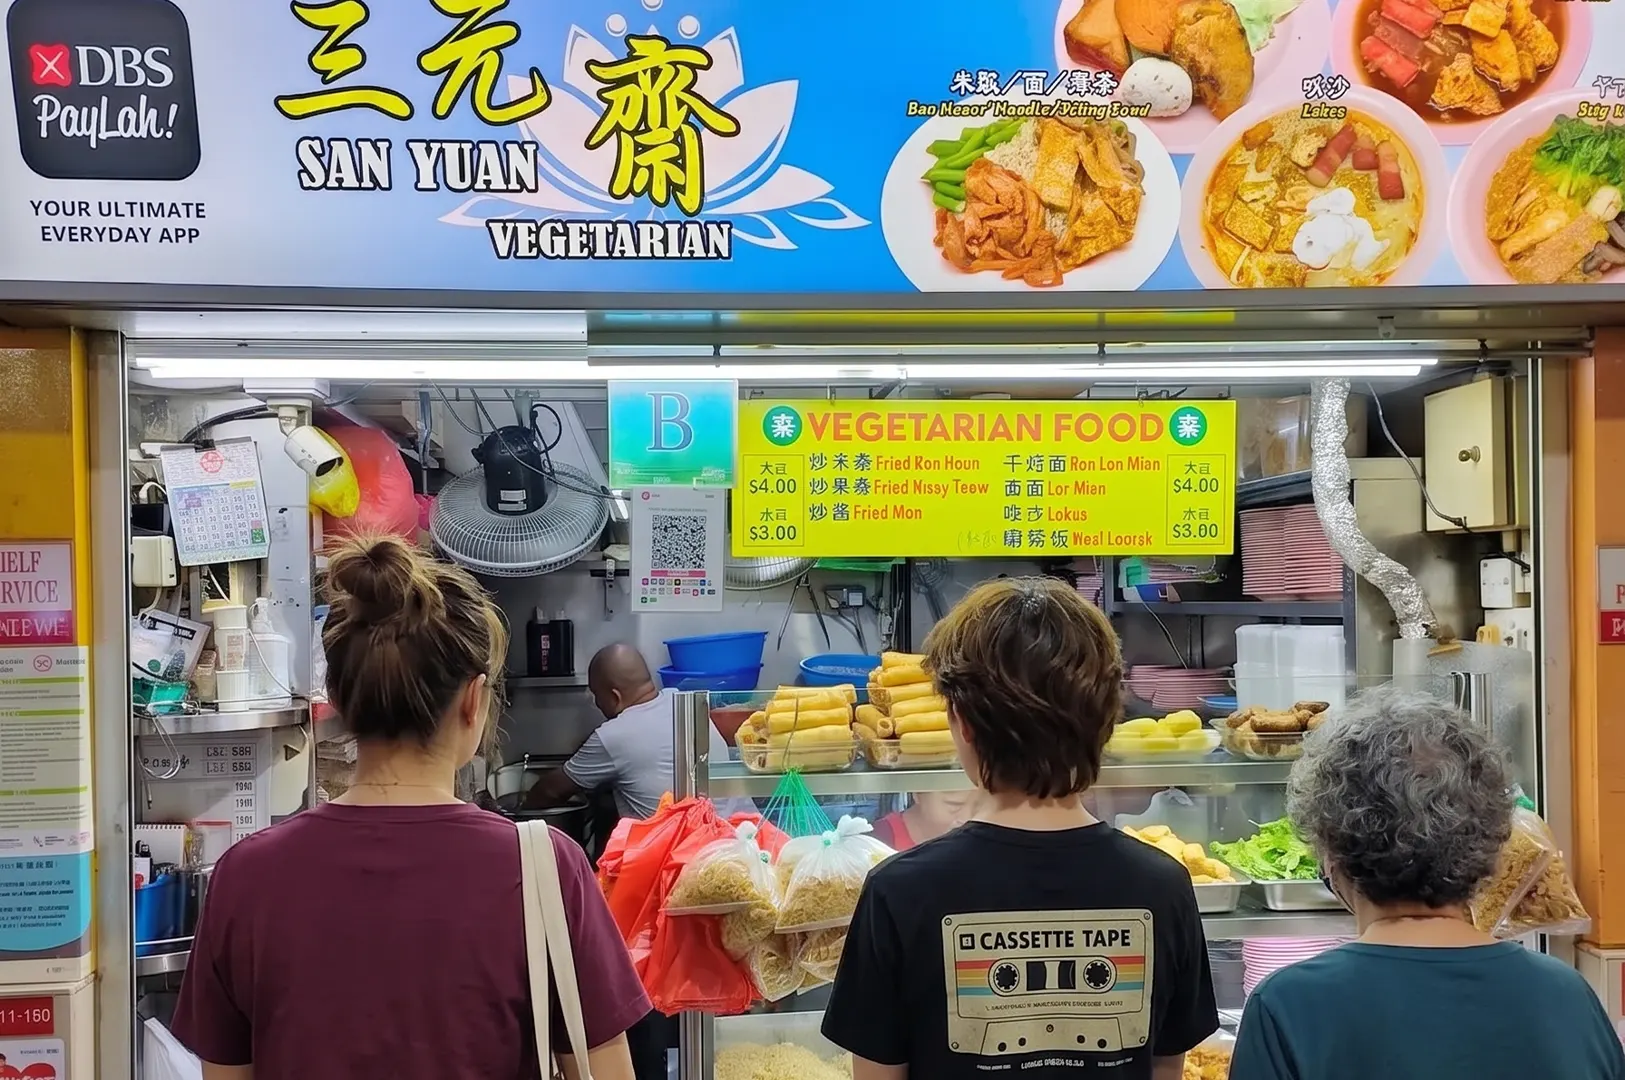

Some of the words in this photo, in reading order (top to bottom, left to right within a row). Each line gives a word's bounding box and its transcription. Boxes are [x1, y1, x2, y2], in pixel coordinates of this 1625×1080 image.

[75, 45, 174, 88] DBS
[32, 94, 180, 148] PayLah!
[297, 137, 392, 191] SAN
[406, 139, 539, 193] YUAN
[30, 200, 91, 218] YOUR
[99, 201, 206, 219] ULTIMATE
[41, 226, 152, 242] EVERYDAY
[159, 227, 200, 244] APP
[487, 219, 732, 260] VEGETARIAN
[646, 391, 694, 452] B
[807, 412, 1041, 442] VEGETARIAN
[1054, 412, 1164, 442] FOOD
[876, 456, 910, 470] Fried
[944, 456, 980, 470] Houn
[1070, 456, 1096, 471] Ron
[1100, 456, 1124, 471] Lon
[1127, 456, 1160, 471] Mian
[749, 478, 797, 494] $4.00
[874, 480, 909, 494] Fried
[1048, 481, 1070, 496] Lor
[1173, 477, 1219, 493] $4.00
[854, 504, 888, 519] Fried
[893, 504, 922, 519] Mon
[1048, 506, 1087, 521] Lokus
[749, 525, 797, 541] $3.00
[980, 930, 1074, 950] CASSETTE
[1083, 929, 1131, 948] TAPE
